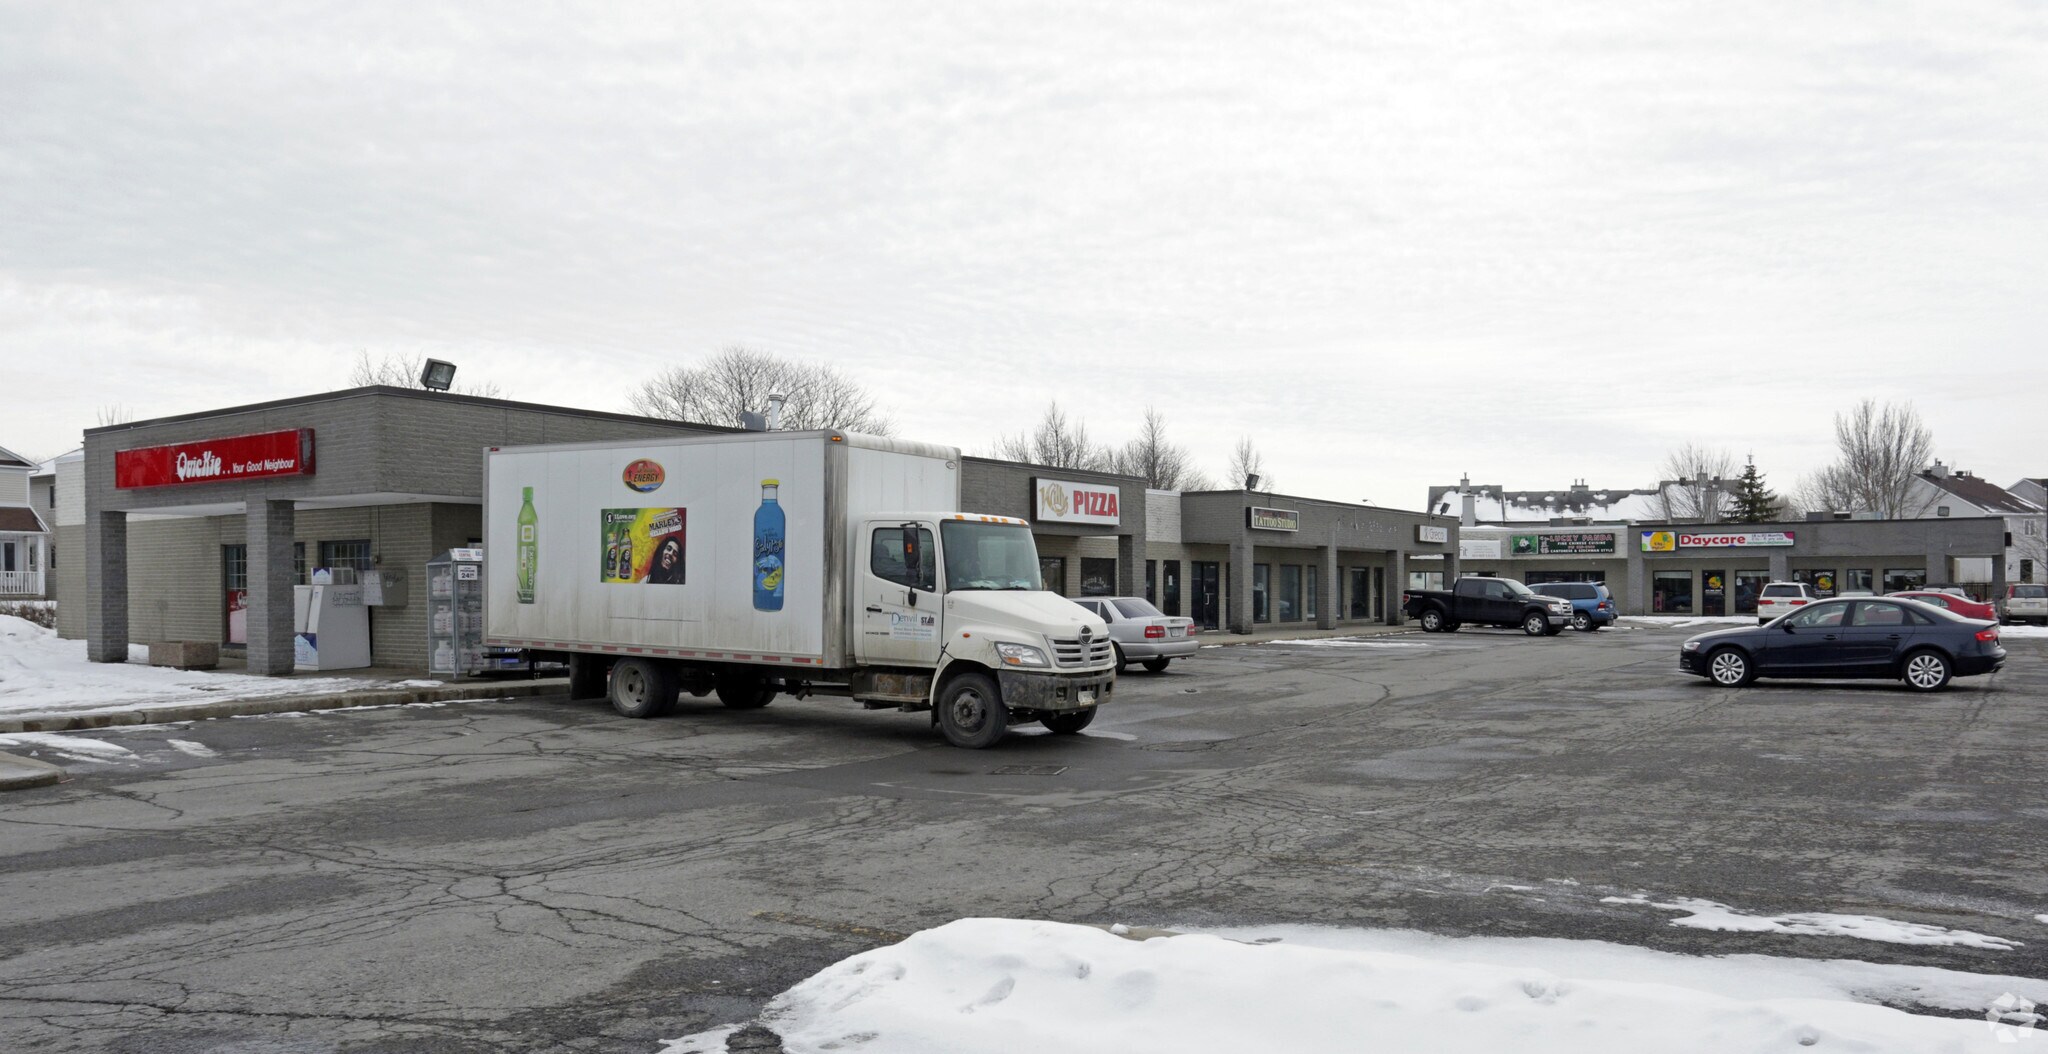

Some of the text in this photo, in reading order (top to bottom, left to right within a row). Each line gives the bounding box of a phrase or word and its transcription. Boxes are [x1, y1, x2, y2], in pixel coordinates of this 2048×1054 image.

[232, 462, 244, 473] Your
[246, 461, 262, 472] Good
[264, 459, 295, 472] Neighbour
[633, 473, 659, 482] ENERGY
[1073, 490, 1118, 517] PIZZA
[1550, 534, 1578, 542] LUCKY
[1680, 535, 1746, 546] Daycare
